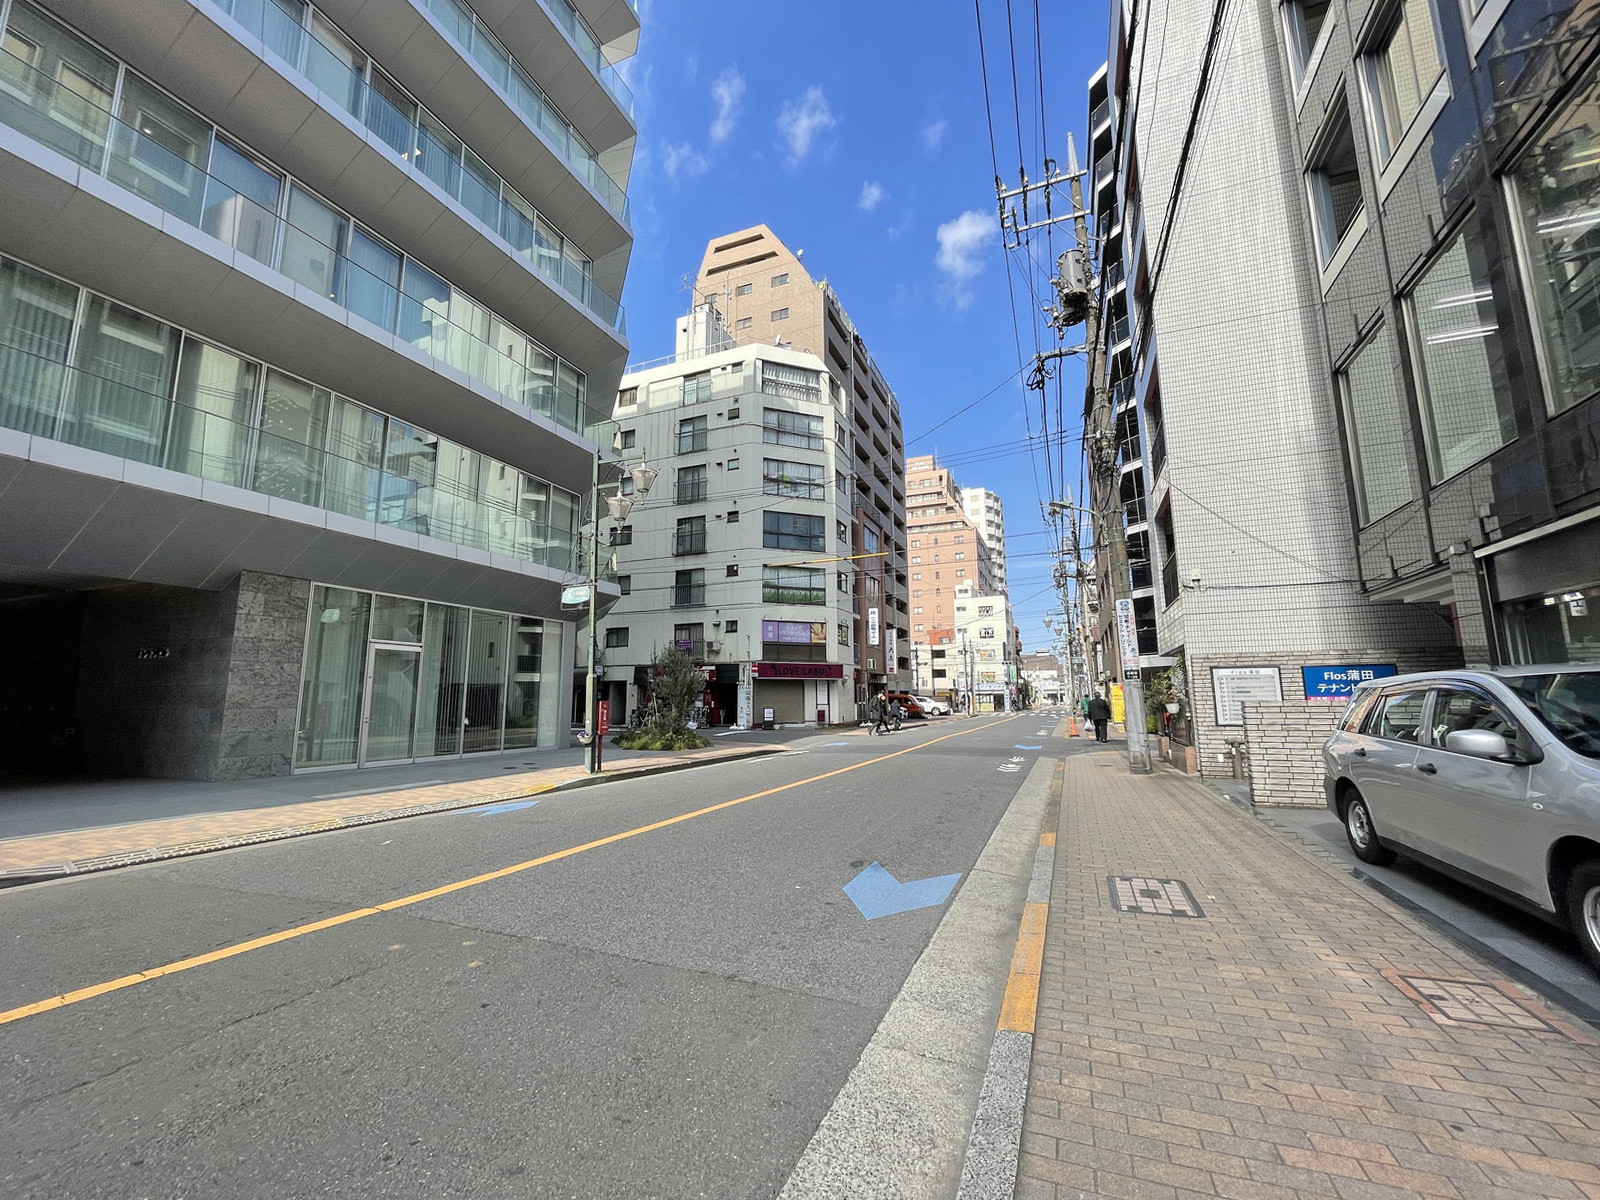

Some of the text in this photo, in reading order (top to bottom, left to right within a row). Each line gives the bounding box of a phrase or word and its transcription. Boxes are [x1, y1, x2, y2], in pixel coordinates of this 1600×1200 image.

[778, 667, 825, 678] LOVE LABO
[1323, 669, 1374, 681] Flos蒲田
